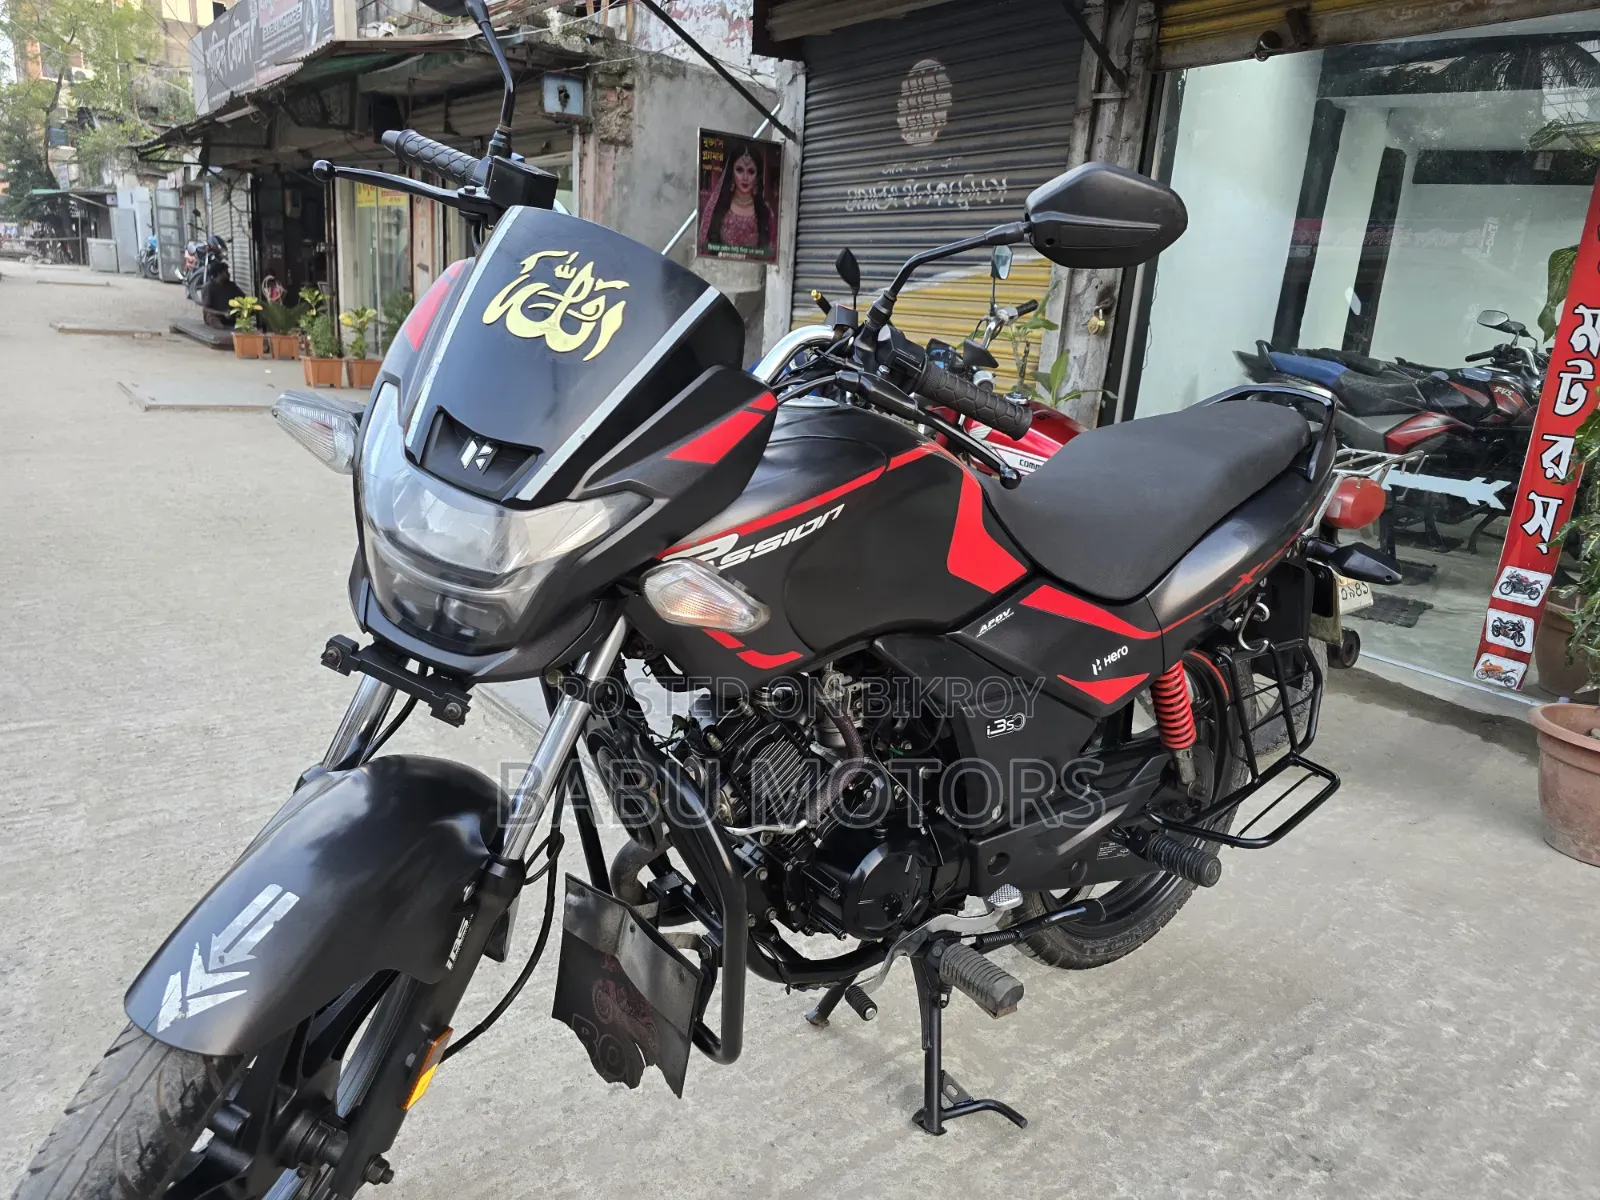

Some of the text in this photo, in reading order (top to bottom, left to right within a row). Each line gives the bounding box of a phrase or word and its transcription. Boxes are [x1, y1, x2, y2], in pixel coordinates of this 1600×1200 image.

[1494, 386, 1515, 397] TVS
[979, 608, 1012, 634] APDV
[1103, 645, 1129, 667] Hero
